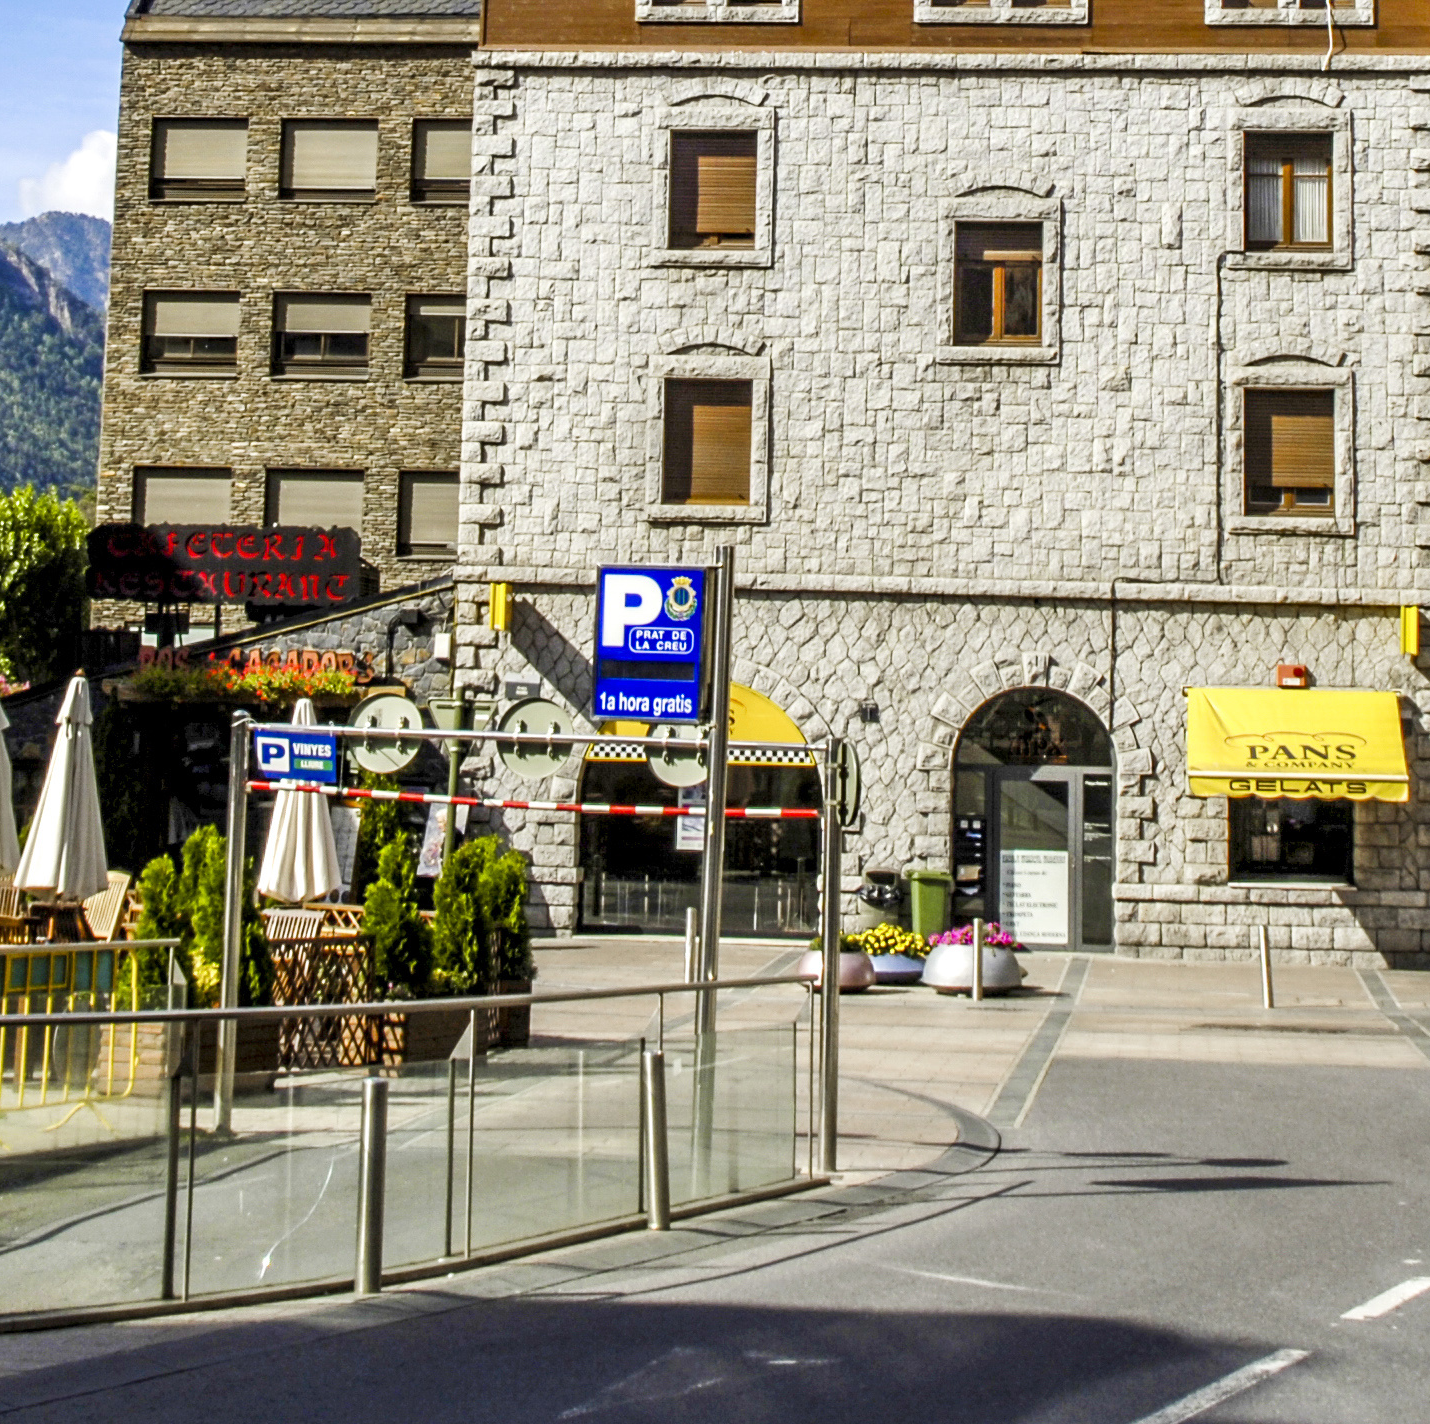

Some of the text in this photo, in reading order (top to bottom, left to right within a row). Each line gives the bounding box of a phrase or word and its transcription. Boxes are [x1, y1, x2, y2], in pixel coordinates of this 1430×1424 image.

[106, 530, 338, 560] CAFETERIA
[95, 569, 351, 601] RESTAURANT
[602, 573, 663, 647] P
[635, 630, 687, 641] PRAT DE
[635, 641, 687, 651] LA CREU
[599, 691, 692, 717] 1a hora gratis
[261, 742, 286, 764] P
[292, 742, 332, 758] VINYES
[1247, 744, 1356, 760] PANS
[1263, 761, 1355, 769] COMPANY
[1229, 778, 1367, 794] GELATS
